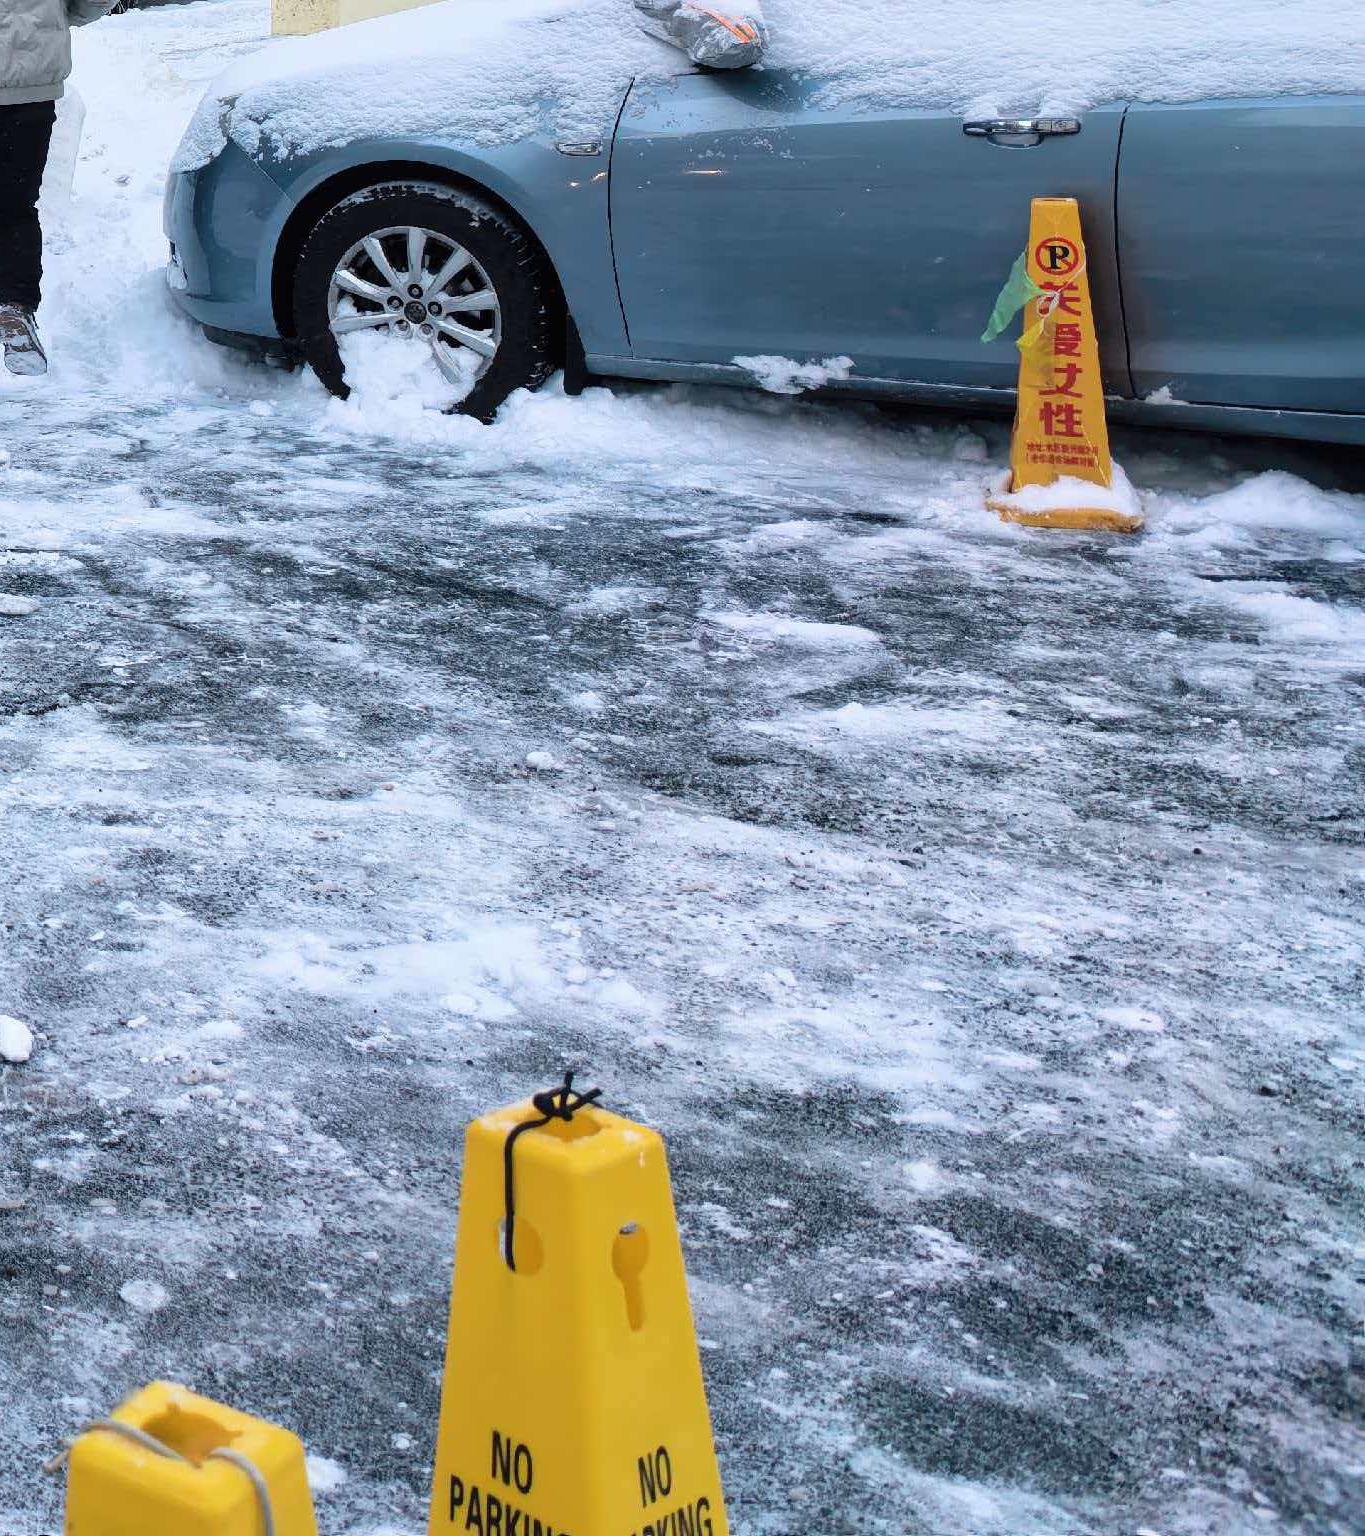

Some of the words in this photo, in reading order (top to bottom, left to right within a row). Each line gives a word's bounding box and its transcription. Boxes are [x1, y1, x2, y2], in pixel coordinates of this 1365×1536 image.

[491, 1430, 533, 1494] NO
[638, 1445, 672, 1508] NO
[450, 1474, 572, 1536] PARK
